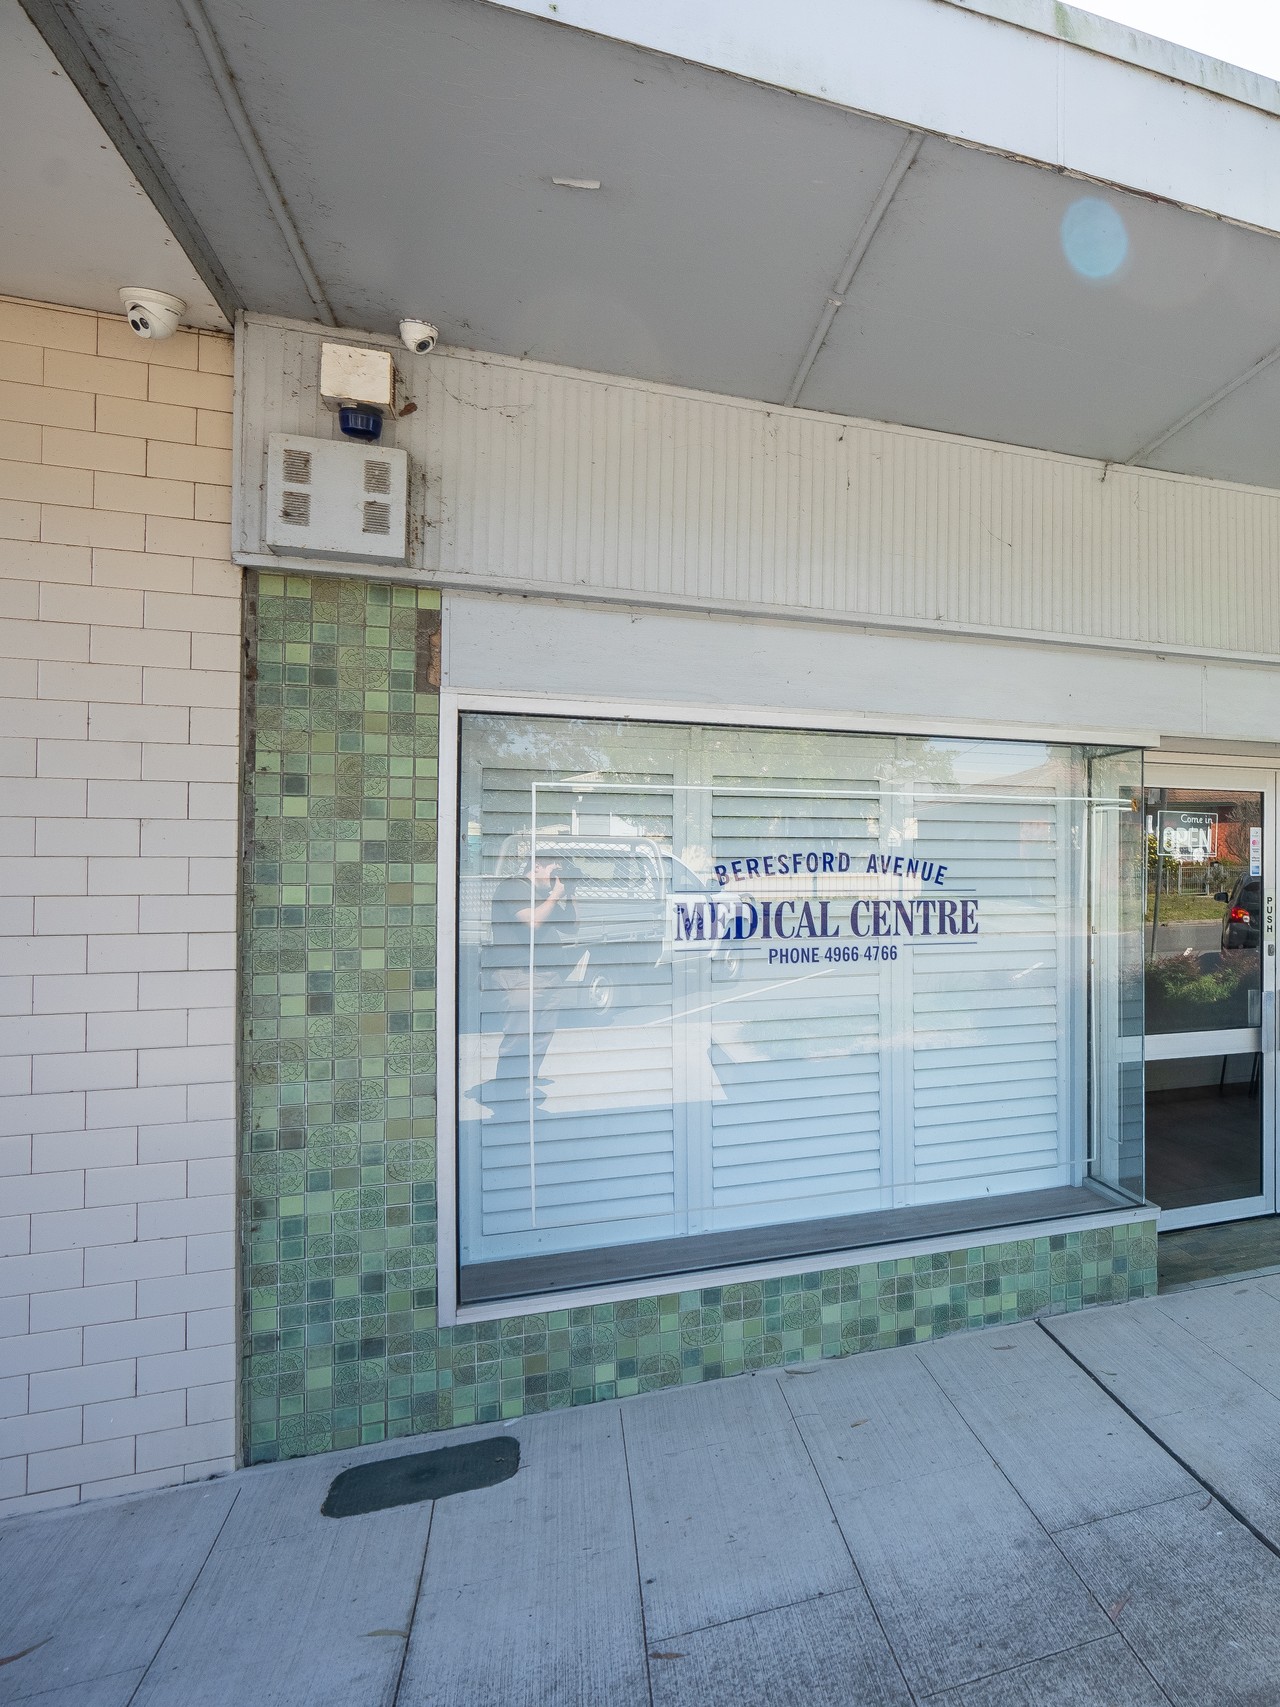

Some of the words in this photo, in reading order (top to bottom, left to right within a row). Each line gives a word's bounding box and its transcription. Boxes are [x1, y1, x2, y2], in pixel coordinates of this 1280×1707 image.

[1180, 814, 1203, 824] Come
[1205, 815, 1213, 824] in
[1163, 826, 1212, 853] OPEN
[714, 852, 850, 886] BERESFORD
[866, 853, 948, 885] AVENUE
[674, 900, 840, 942] MEDICAL
[850, 899, 979, 937] CENTRE
[768, 947, 820, 965] PHONE
[824, 946, 859, 962] 4966
[863, 945, 898, 961] 4766
